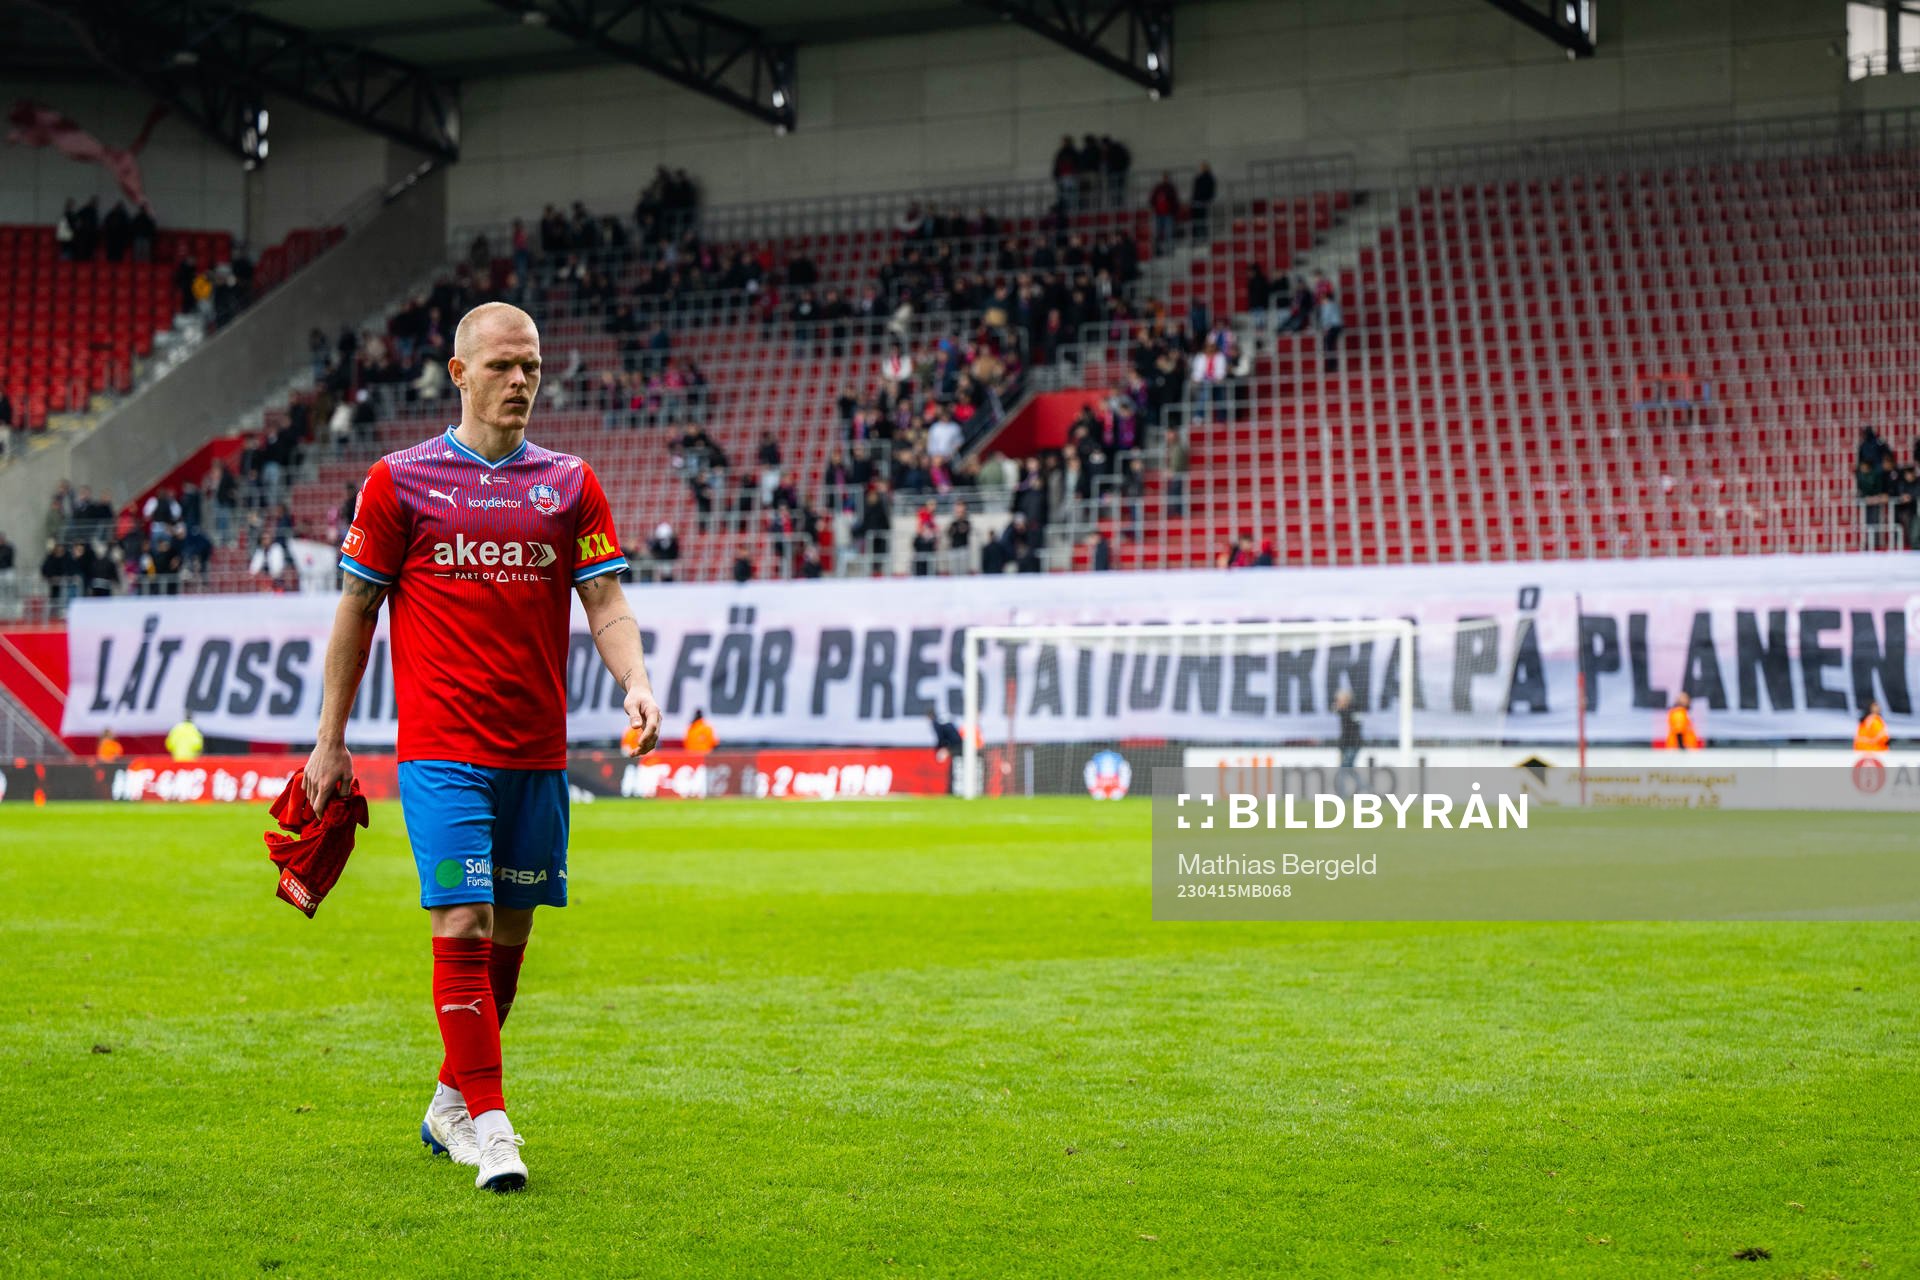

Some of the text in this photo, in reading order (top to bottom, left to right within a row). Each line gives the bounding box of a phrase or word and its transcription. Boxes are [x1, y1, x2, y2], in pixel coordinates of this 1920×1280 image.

[468, 496, 522, 508] kondektor
[434, 533, 523, 567] akea
[576, 532, 616, 561] XXL
[455, 572, 539, 582] PART OF ELEDA
[89, 613, 183, 714] LÅT
[184, 638, 311, 717] OSS
[666, 598, 794, 715] FÖR
[810, 618, 1426, 720] PRESTATIONERNA
[1452, 585, 1548, 715] PÅ
[1577, 608, 1912, 715] PLANEN
[1217, 755, 1428, 802] tillmobl
[465, 858, 491, 875] Solid
[495, 866, 547, 885] RSA
[282, 878, 317, 910] UNIBET
